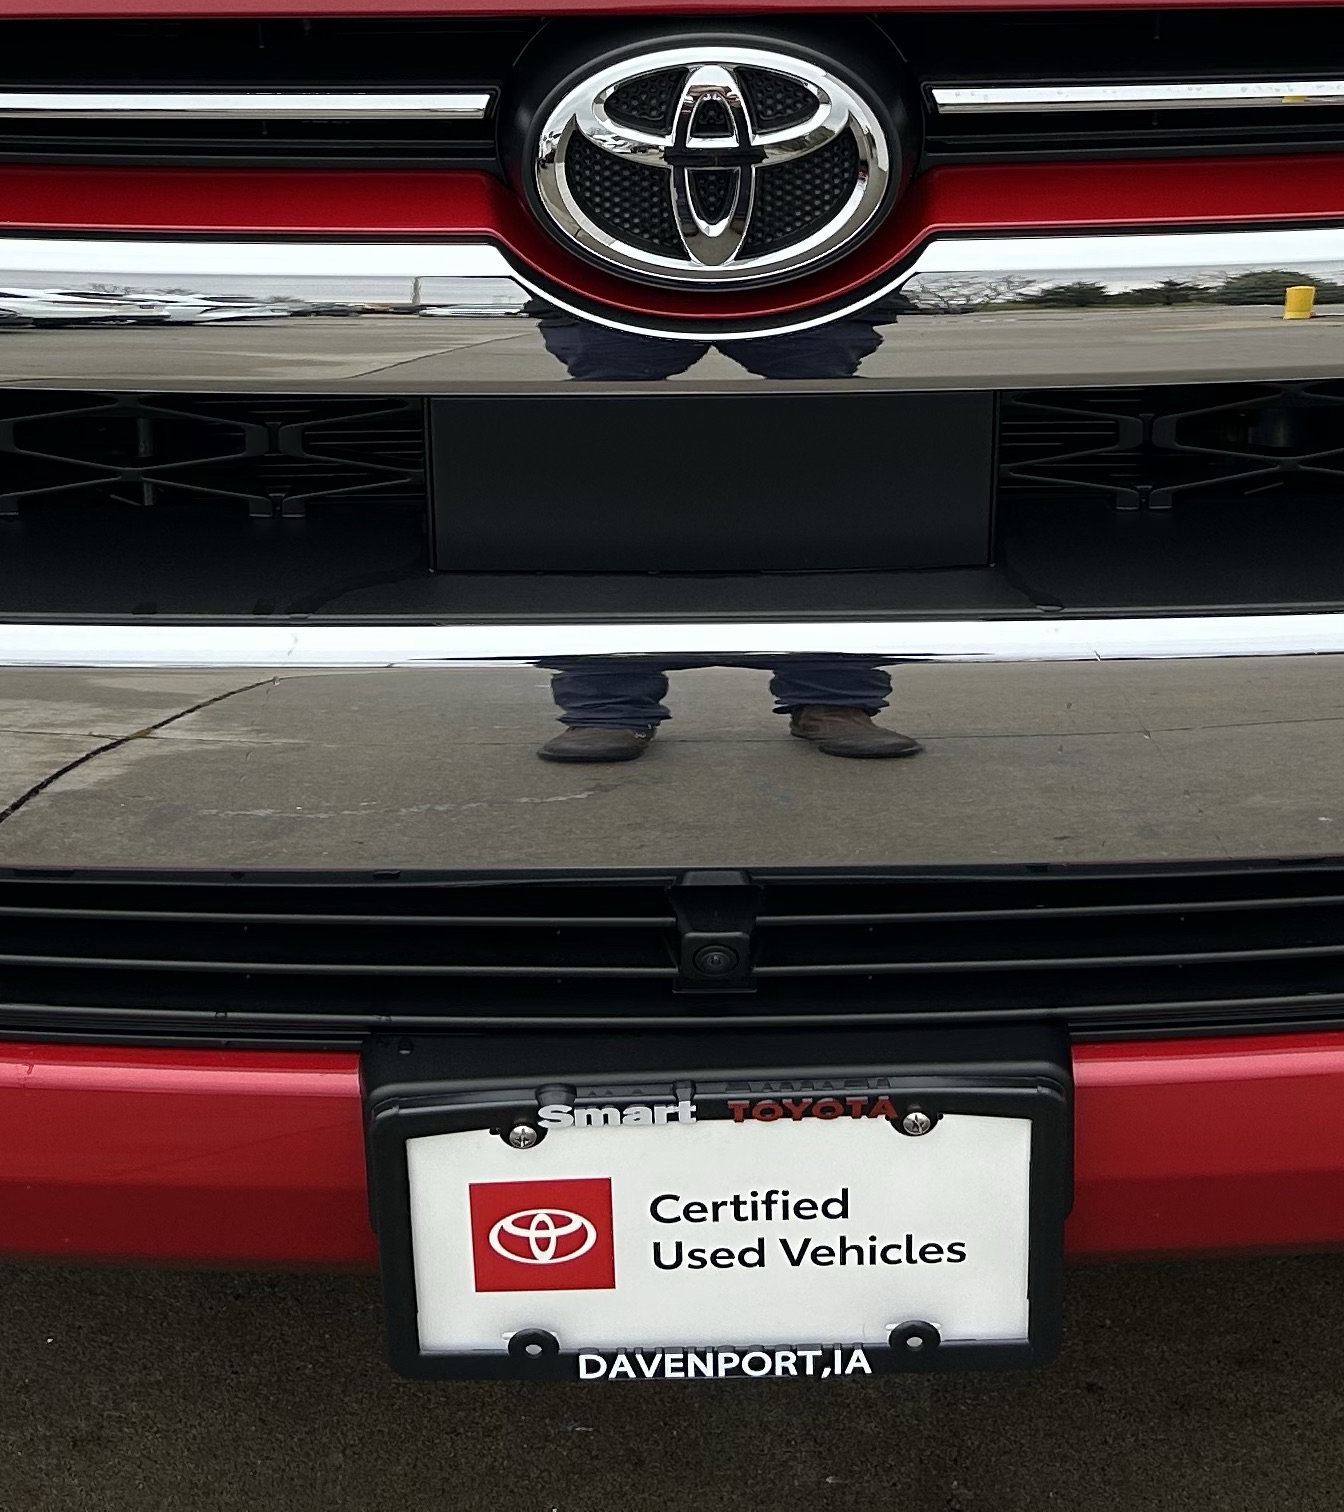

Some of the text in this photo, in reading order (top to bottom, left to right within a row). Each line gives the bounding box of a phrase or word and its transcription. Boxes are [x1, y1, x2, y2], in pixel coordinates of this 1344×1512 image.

[538, 1096, 898, 1129] Smart TOYOTA
[649, 1188, 850, 1224] Certified
[652, 1234, 967, 1270] Used Vehicles
[578, 1349, 872, 1379] DAVENPORT,IA
